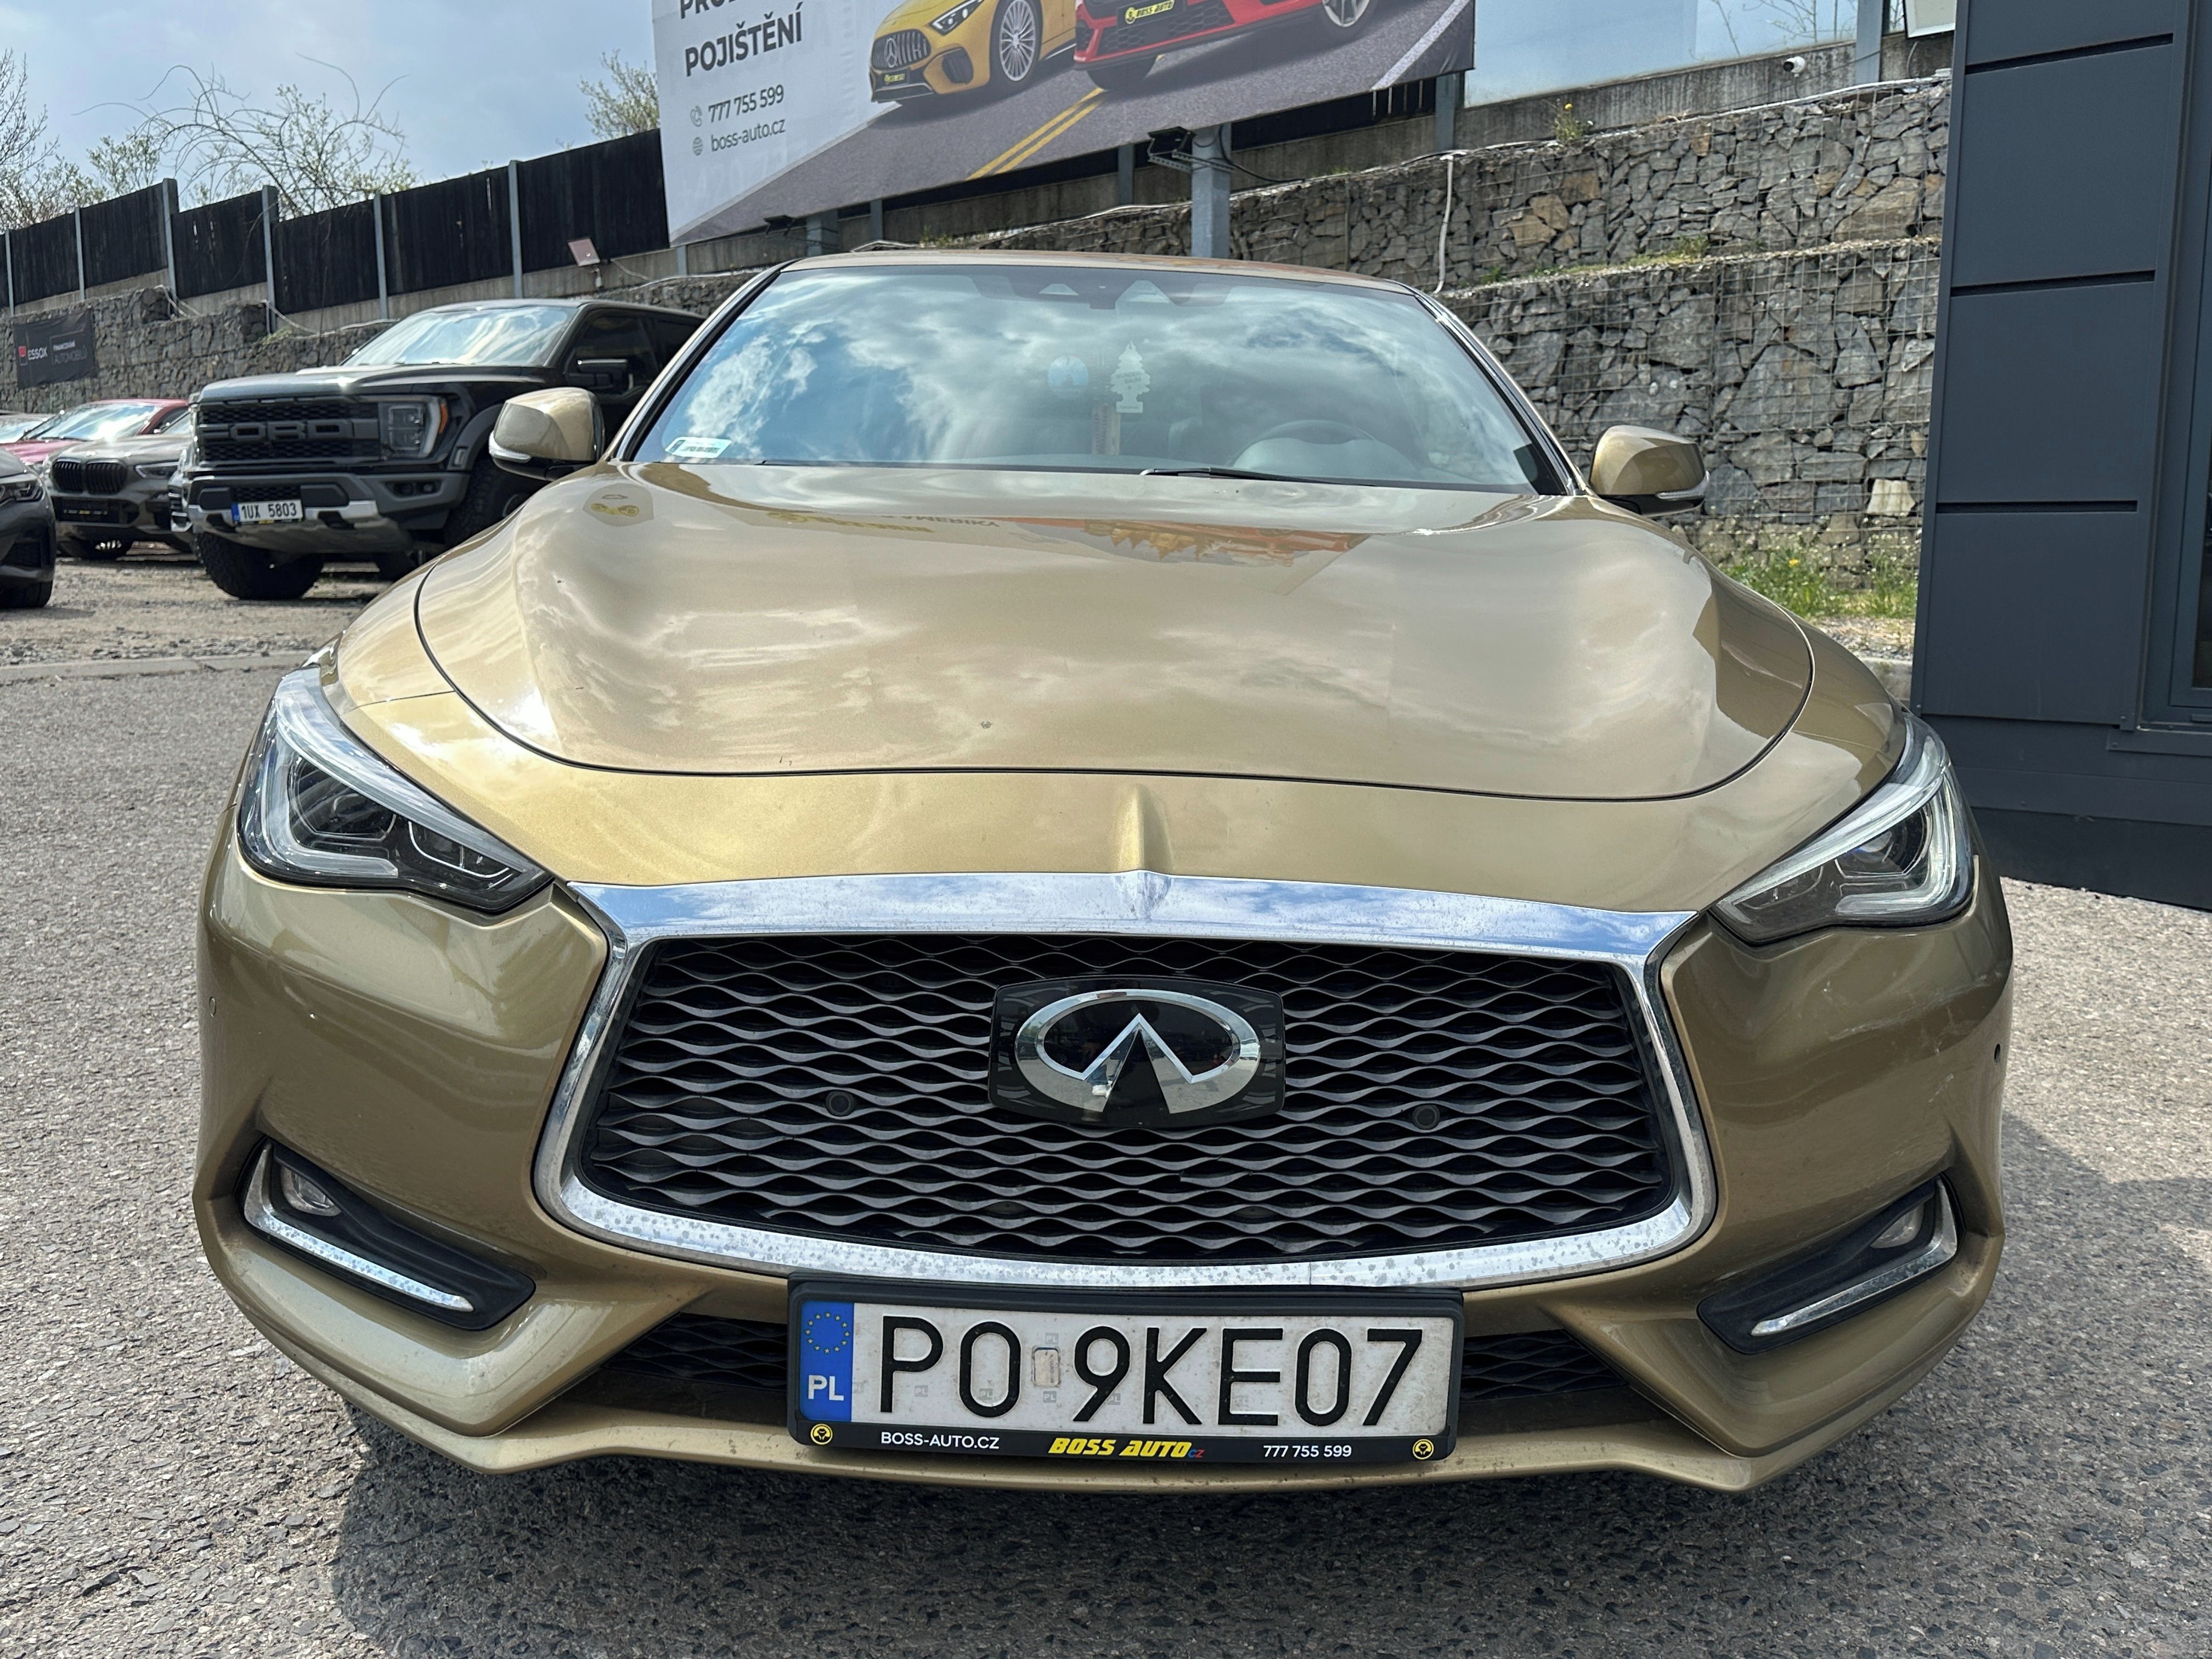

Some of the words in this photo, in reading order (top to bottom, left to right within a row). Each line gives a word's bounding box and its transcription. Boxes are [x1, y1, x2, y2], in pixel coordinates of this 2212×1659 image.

[685, 2, 803, 77] POJIŠTĚNÍ
[708, 99, 731, 123] 777
[734, 92, 757, 116] 755
[759, 84, 785, 108] 599
[710, 119, 786, 153] boss-auto.cz
[27, 347, 48, 360] ESSOX
[197, 419, 352, 444] FORD
[241, 504, 261, 519] 1UX
[268, 502, 297, 517] 5803
[880, 1315, 1022, 1418] PO
[1072, 1325, 1423, 1427] 9KE07
[808, 1375, 845, 1402] PL
[881, 1431, 999, 1449] BOSS-AUTO.CZ
[1048, 1437, 1116, 1455] BOSS
[1263, 1445, 1289, 1458] 777
[1292, 1445, 1319, 1458] 755
[1323, 1444, 1352, 1458] 599
